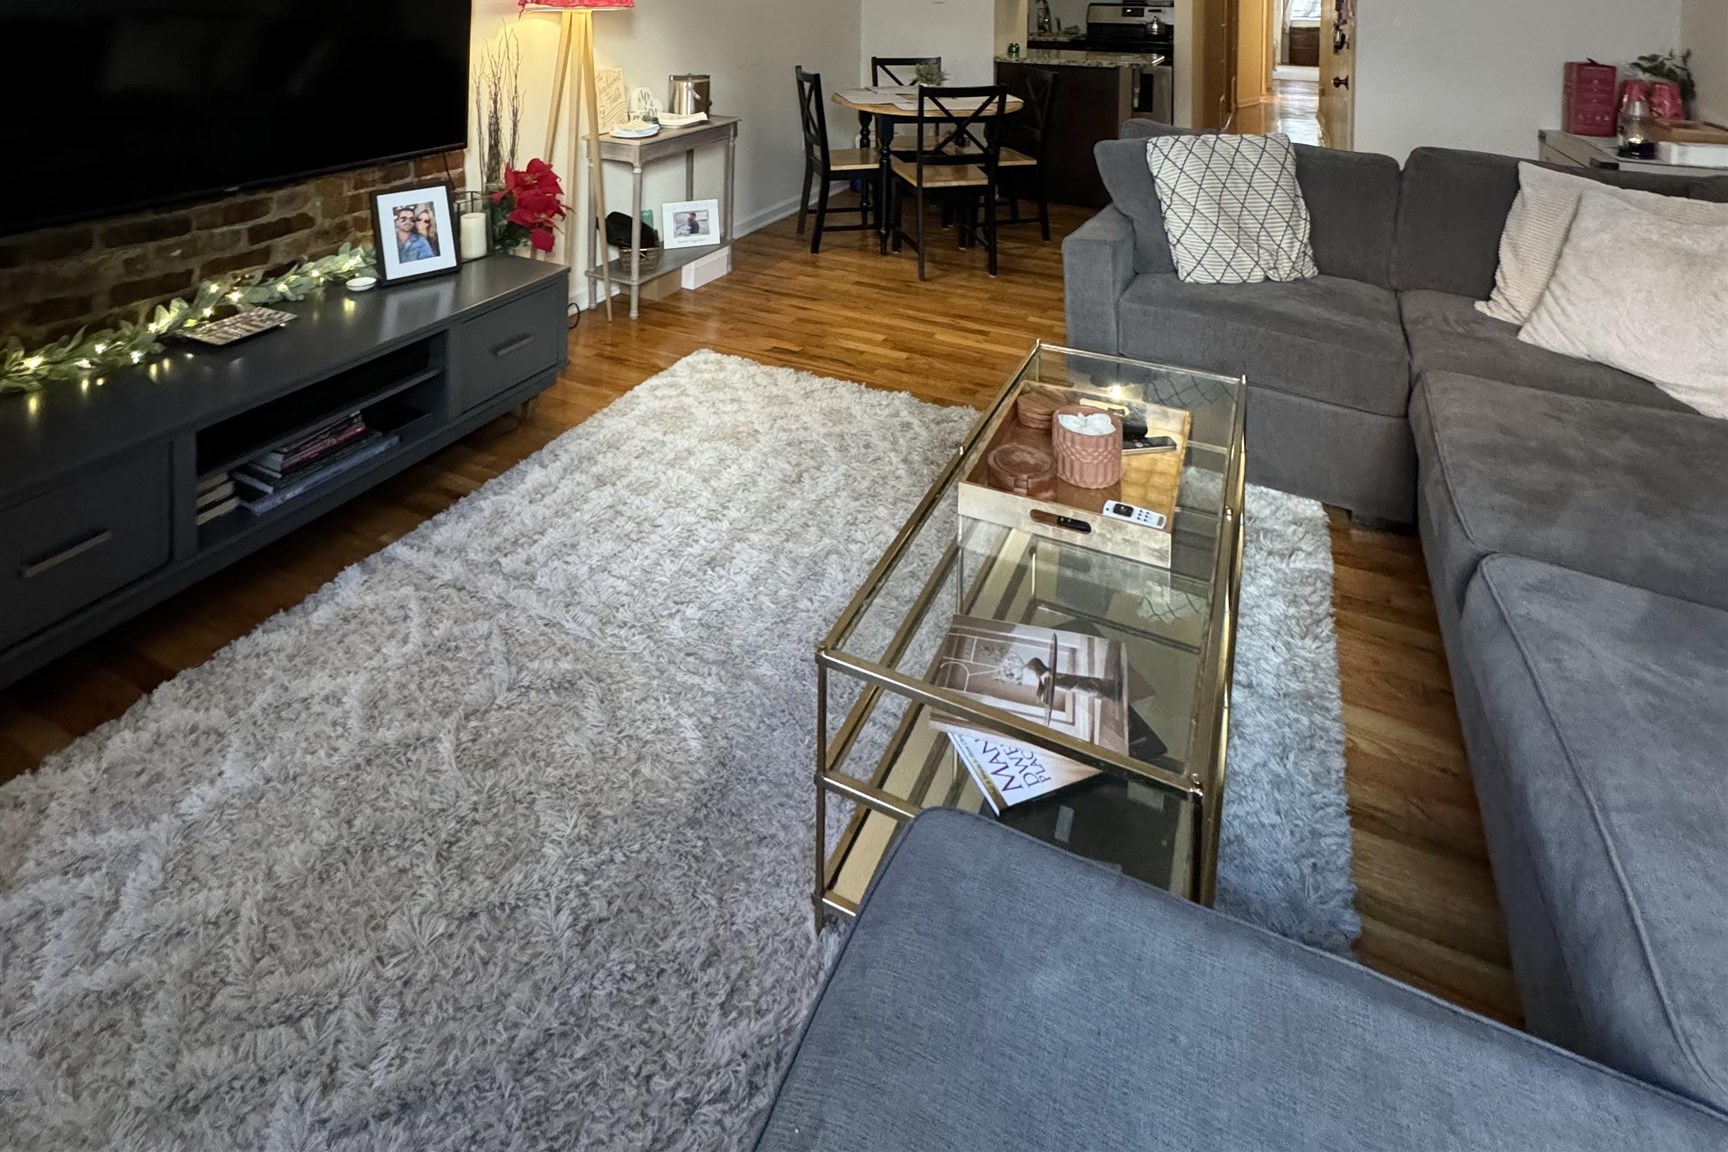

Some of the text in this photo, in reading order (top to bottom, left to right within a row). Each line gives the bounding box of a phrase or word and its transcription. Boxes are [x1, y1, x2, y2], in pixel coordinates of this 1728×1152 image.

[975, 738, 1025, 793] MAN
[1000, 744, 1041, 788] DWE
[1021, 750, 1052, 783] PLAC
